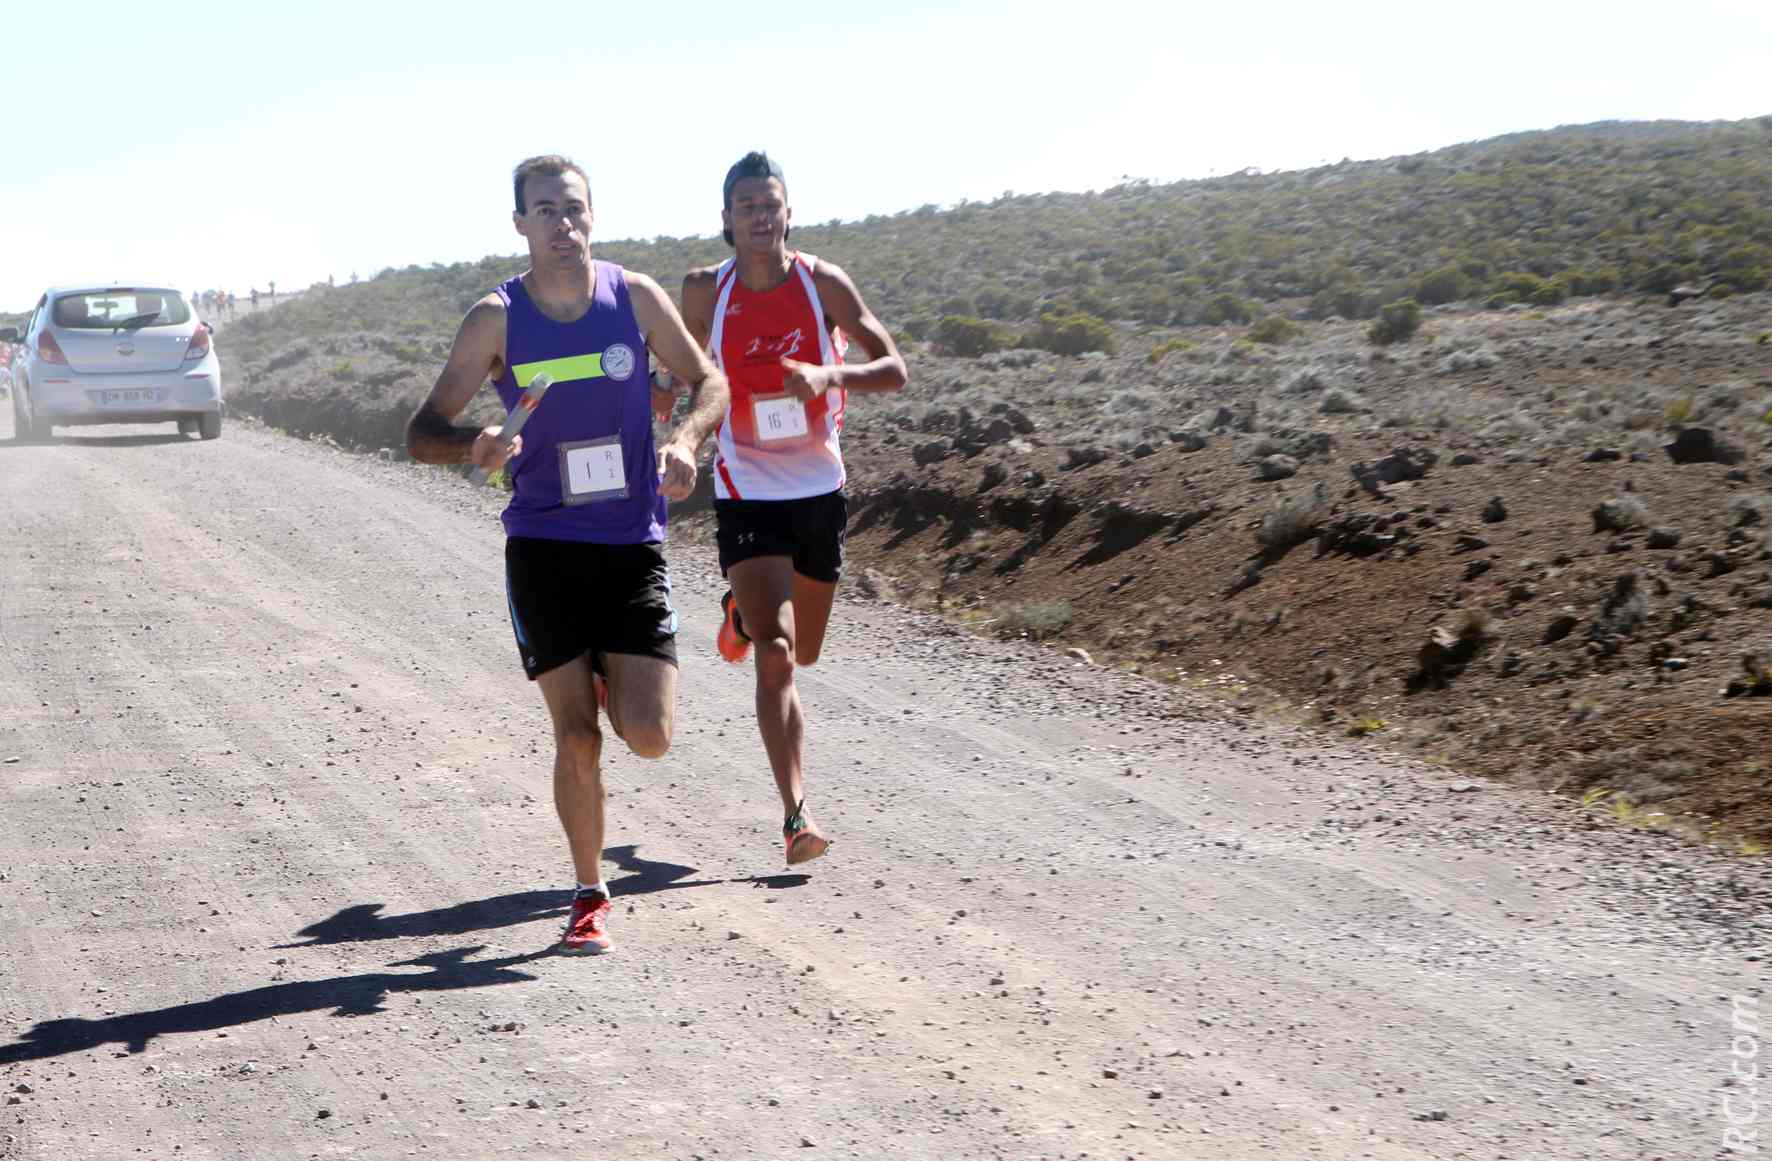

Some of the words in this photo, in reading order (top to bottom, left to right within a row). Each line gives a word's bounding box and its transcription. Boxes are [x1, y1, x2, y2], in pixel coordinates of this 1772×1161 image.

[768, 411, 782, 430] 16
[604, 449, 614, 461] R
[586, 461, 592, 480] 1
